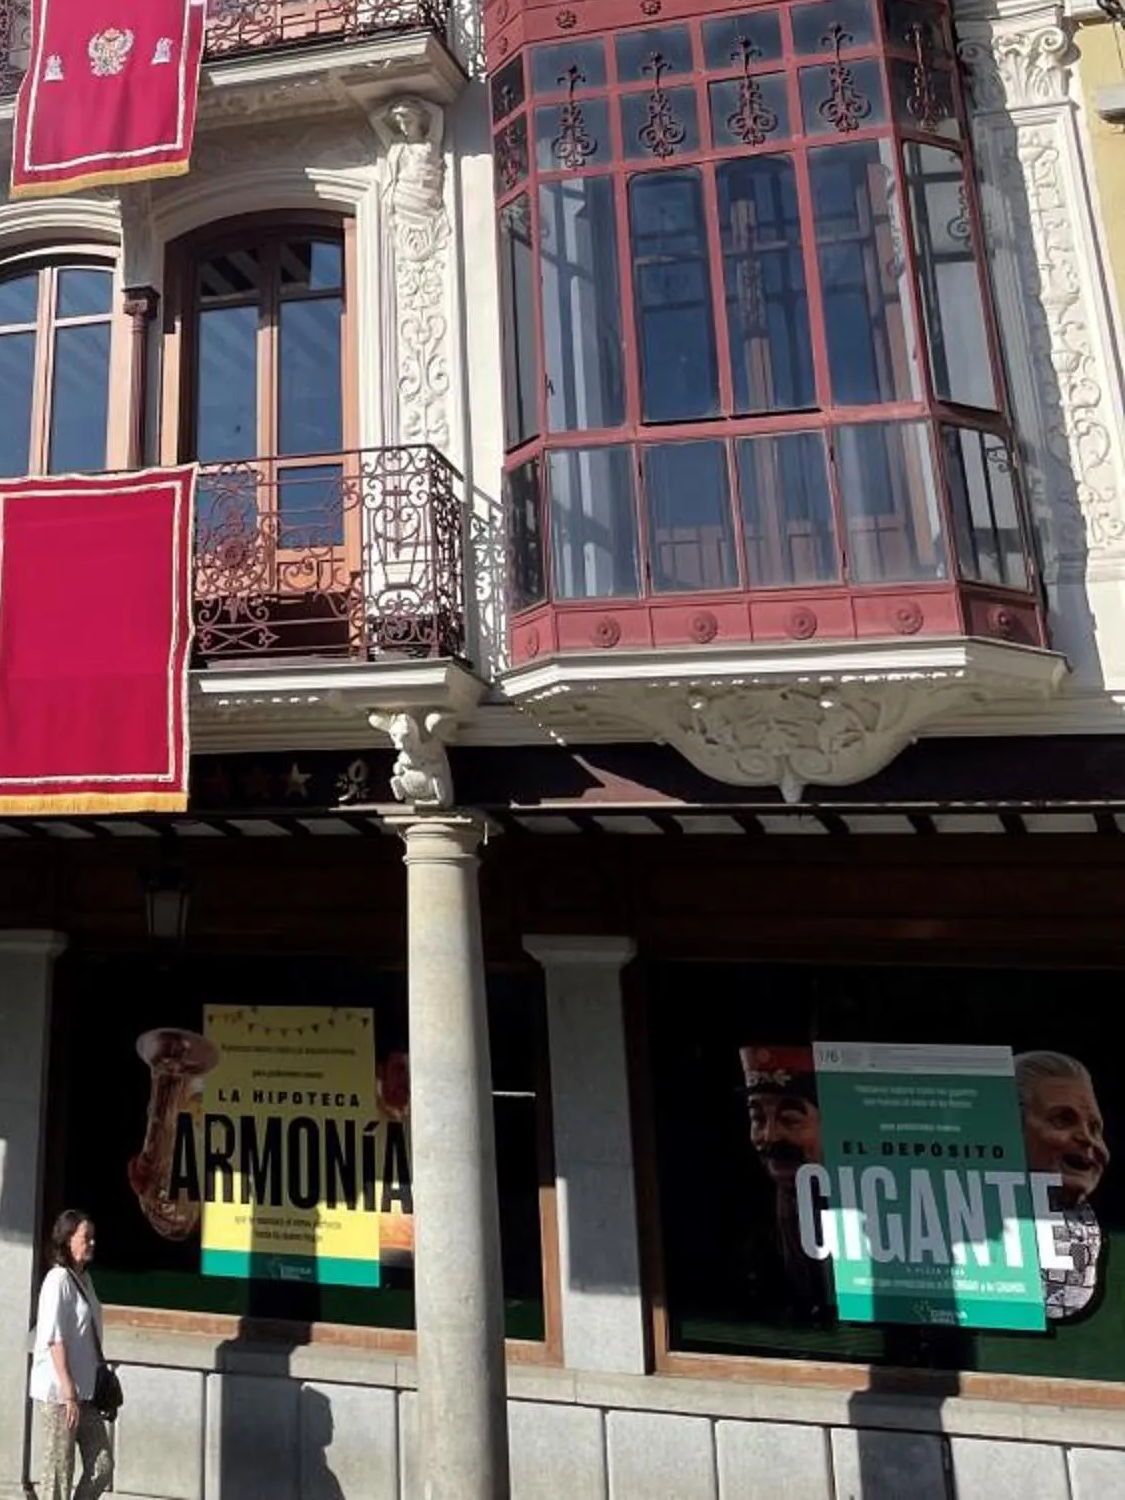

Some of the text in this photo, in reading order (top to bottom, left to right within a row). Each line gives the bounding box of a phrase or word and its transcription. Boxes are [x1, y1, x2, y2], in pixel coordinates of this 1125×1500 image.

[218, 1089, 360, 1108] LA HIPOTECA
[169, 1111, 414, 1214] ARMONÍA
[842, 1140, 1006, 1160] EL DEPÓSITO
[794, 1162, 1075, 1271] GIGANTE
